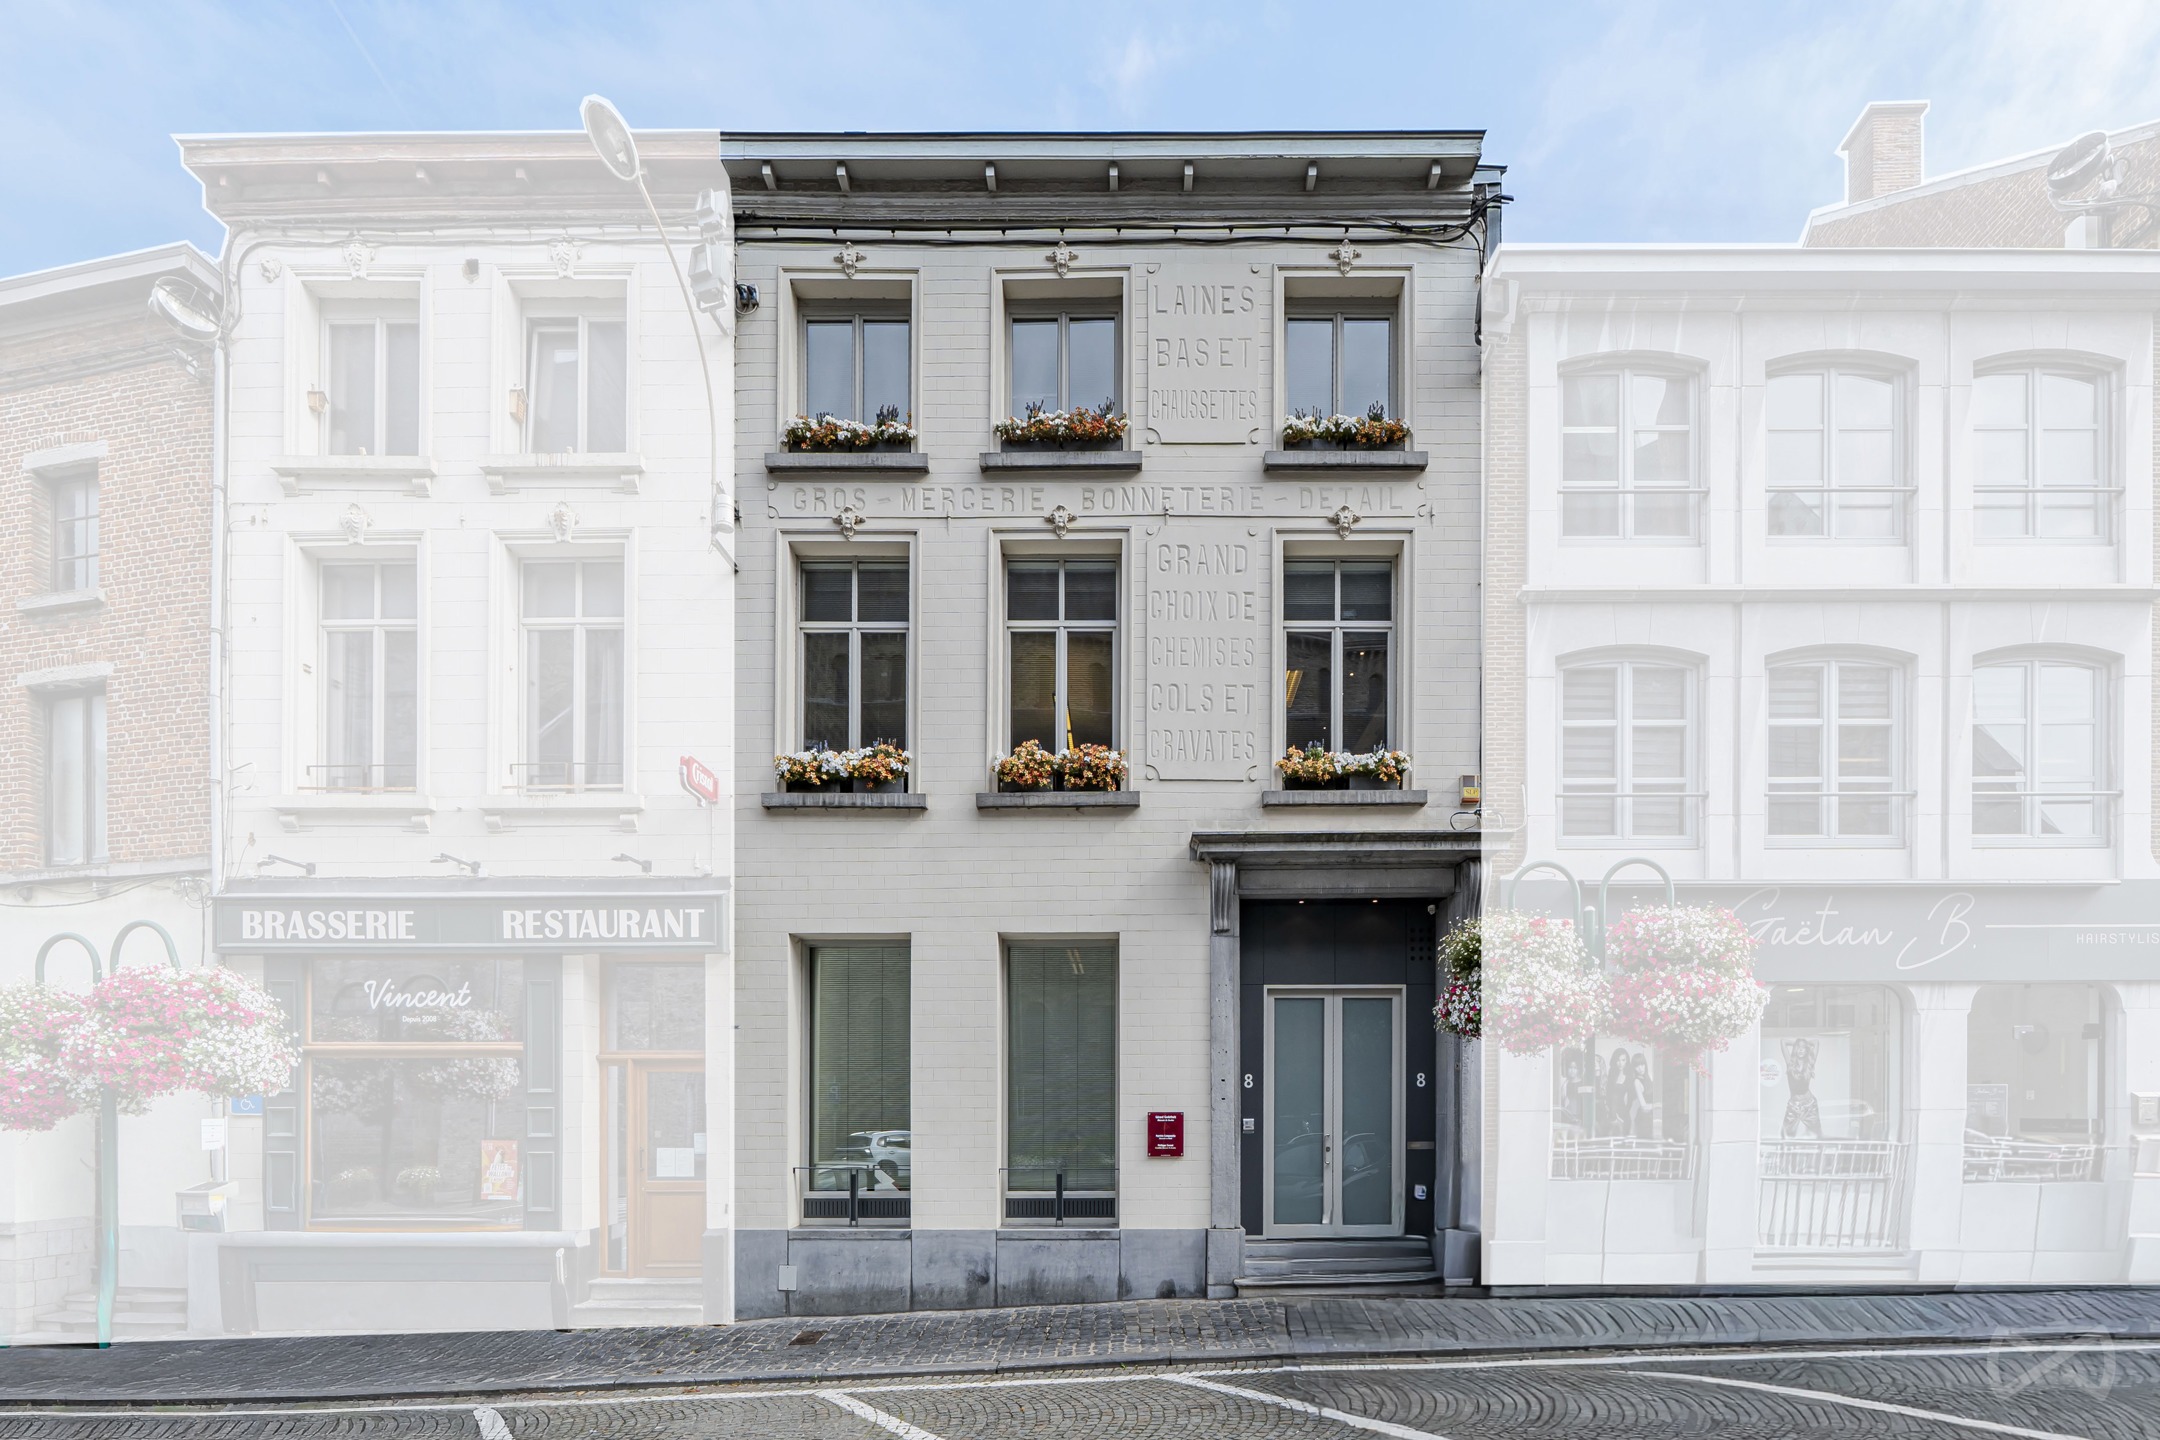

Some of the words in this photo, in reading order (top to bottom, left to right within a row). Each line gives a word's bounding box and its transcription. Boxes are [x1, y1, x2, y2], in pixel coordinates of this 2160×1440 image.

[1153, 285, 1255, 315] LAINES
[1155, 338, 1211, 368] BAS
[1219, 337, 1253, 368] ET
[1151, 389, 1257, 420] CHAUSSETTES
[793, 487, 866, 512] GROS
[900, 487, 1046, 512] MERCERIE
[1082, 486, 1265, 512] BONNETERIE
[1299, 486, 1404, 512] DETAIL
[1156, 543, 1249, 575] GRAND
[1149, 590, 1218, 621] CHOIX
[1225, 591, 1256, 621] DE
[1151, 636, 1255, 668] CHEMISES
[1151, 683, 1214, 713] COLS
[1224, 683, 1255, 714] ET
[1149, 729, 1255, 762] CRAVATES
[242, 910, 416, 940] BRASSERIE
[502, 908, 705, 940] RESTAURANT
[1732, 886, 1893, 947] Gaëtan
[363, 978, 472, 1010] Vincent
[402, 1015, 421, 1023] Depuis
[422, 1015, 437, 1023] 2008
[1243, 1073, 1254, 1089] 8
[1416, 1072, 1427, 1088] 8
